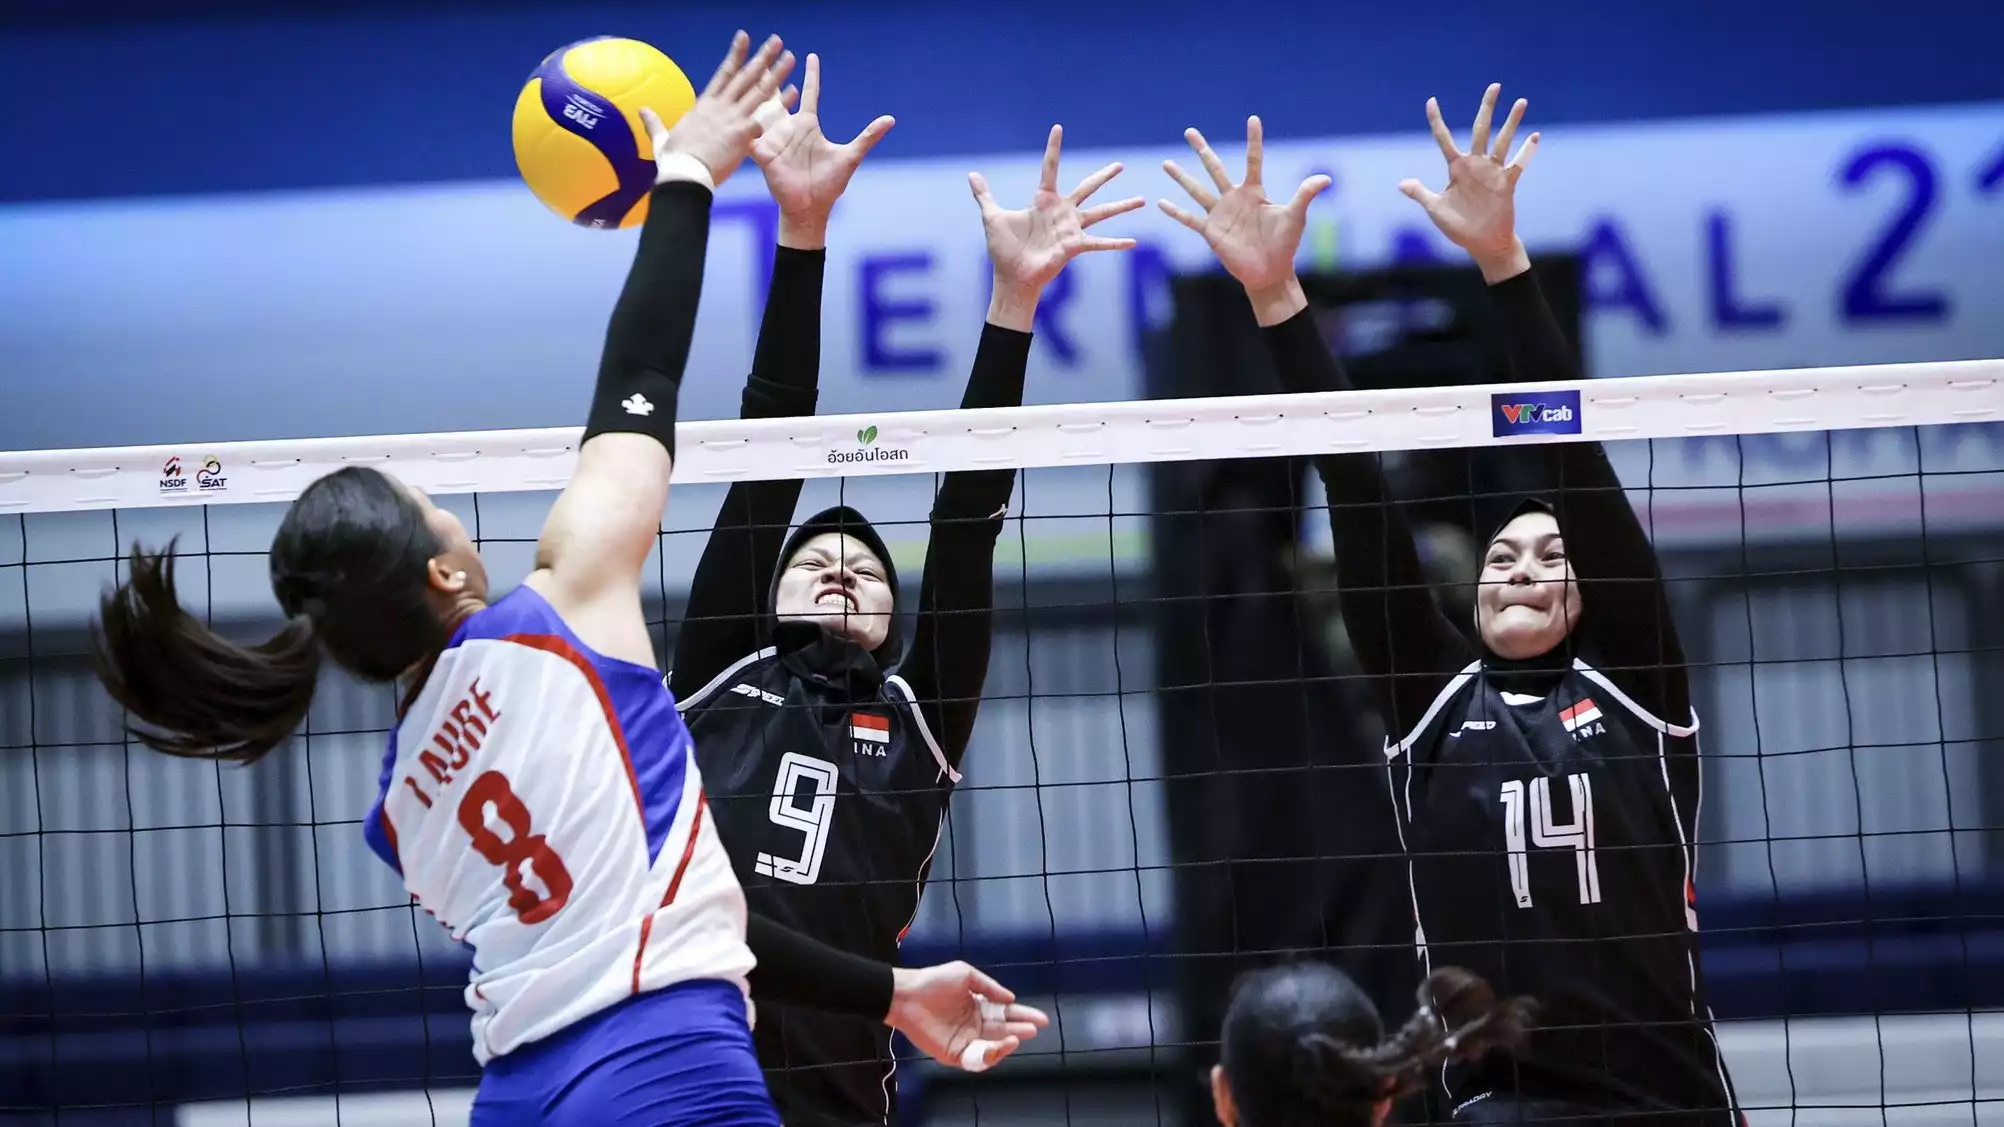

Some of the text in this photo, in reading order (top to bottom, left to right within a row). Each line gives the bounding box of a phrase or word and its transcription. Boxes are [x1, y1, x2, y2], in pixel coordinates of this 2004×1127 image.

[1501, 403, 1573, 424] VTVcab
[827, 447, 909, 463] อ้วยอันโอสถ
[159, 478, 187, 488] NSDF
[199, 477, 228, 488] SAT
[853, 742, 887, 757] INA
[754, 751, 839, 886] 9
[457, 770, 573, 925] 8
[1499, 772, 1601, 909] 14
